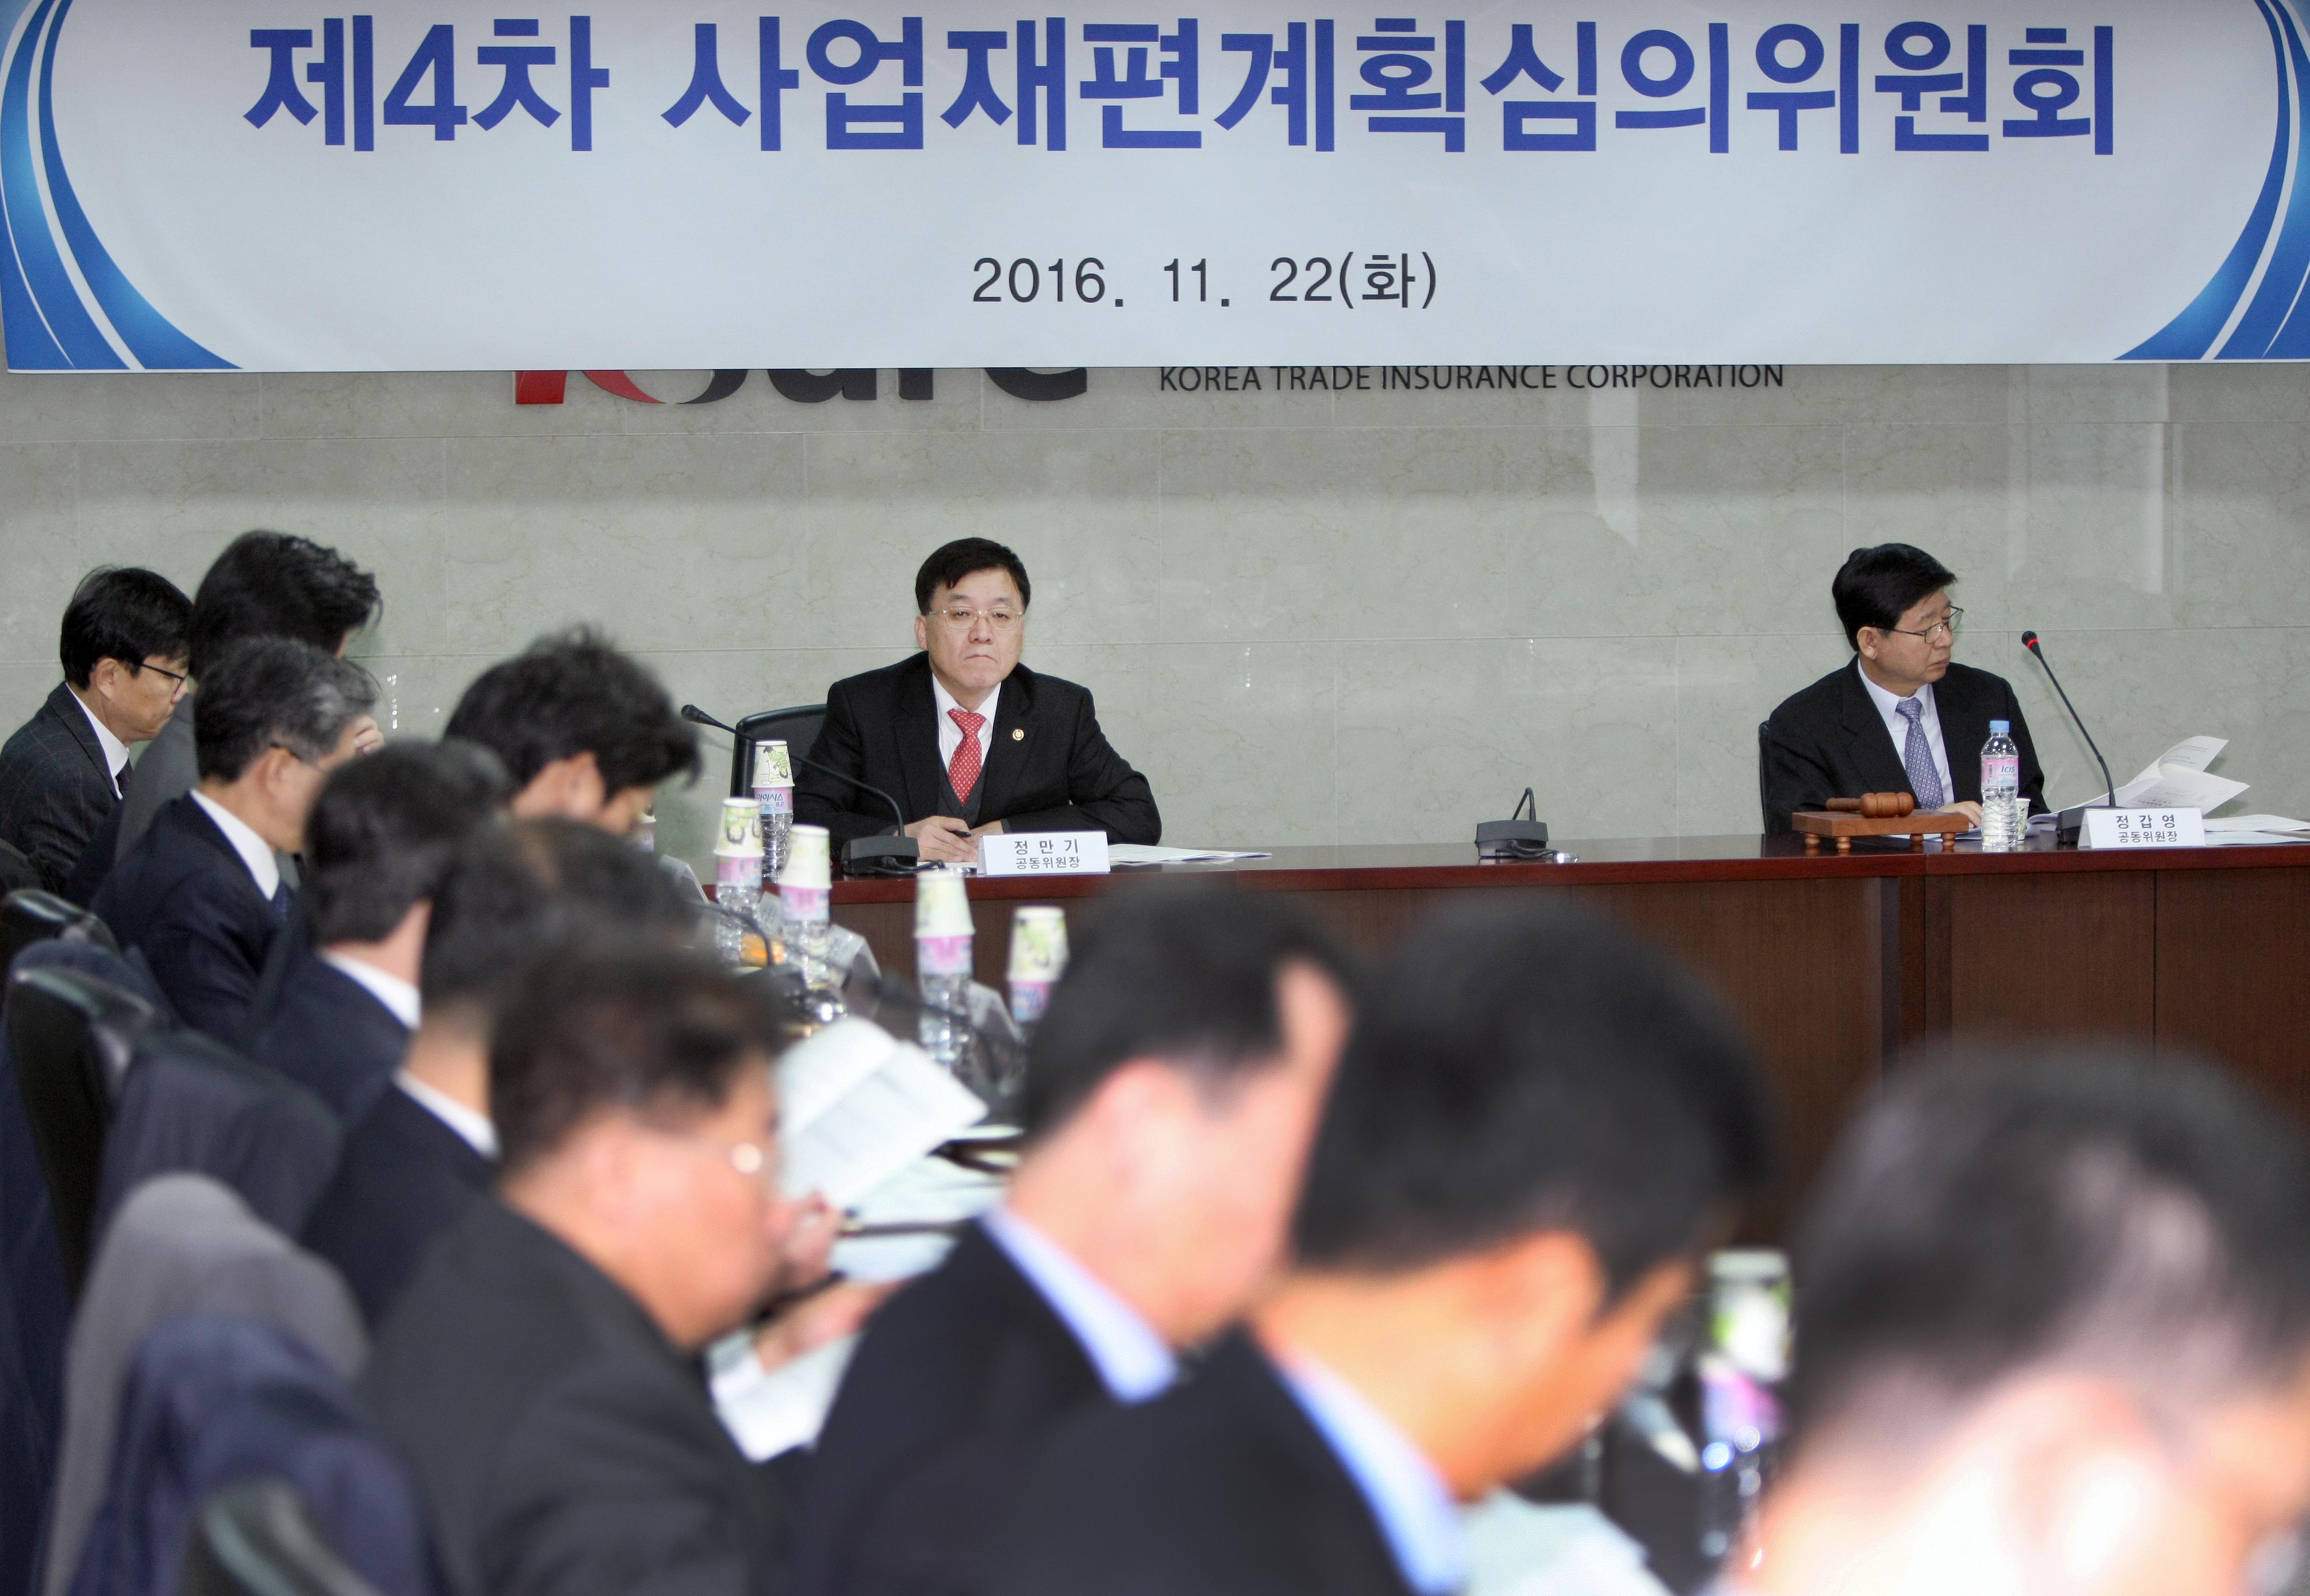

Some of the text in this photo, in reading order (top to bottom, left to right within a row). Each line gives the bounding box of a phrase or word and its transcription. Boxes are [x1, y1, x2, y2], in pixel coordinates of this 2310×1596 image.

[243, 15, 2114, 155] 제4차 사업재편계획심의위원회
[972, 251, 1437, 310] 2016. 11. 22(화)
[1160, 365, 1784, 392] KOREA TRADE INSURANCE CORPORATION
[2118, 830, 2178, 843] 공동위원장
[1015, 856, 1080, 870] 공동위원장
